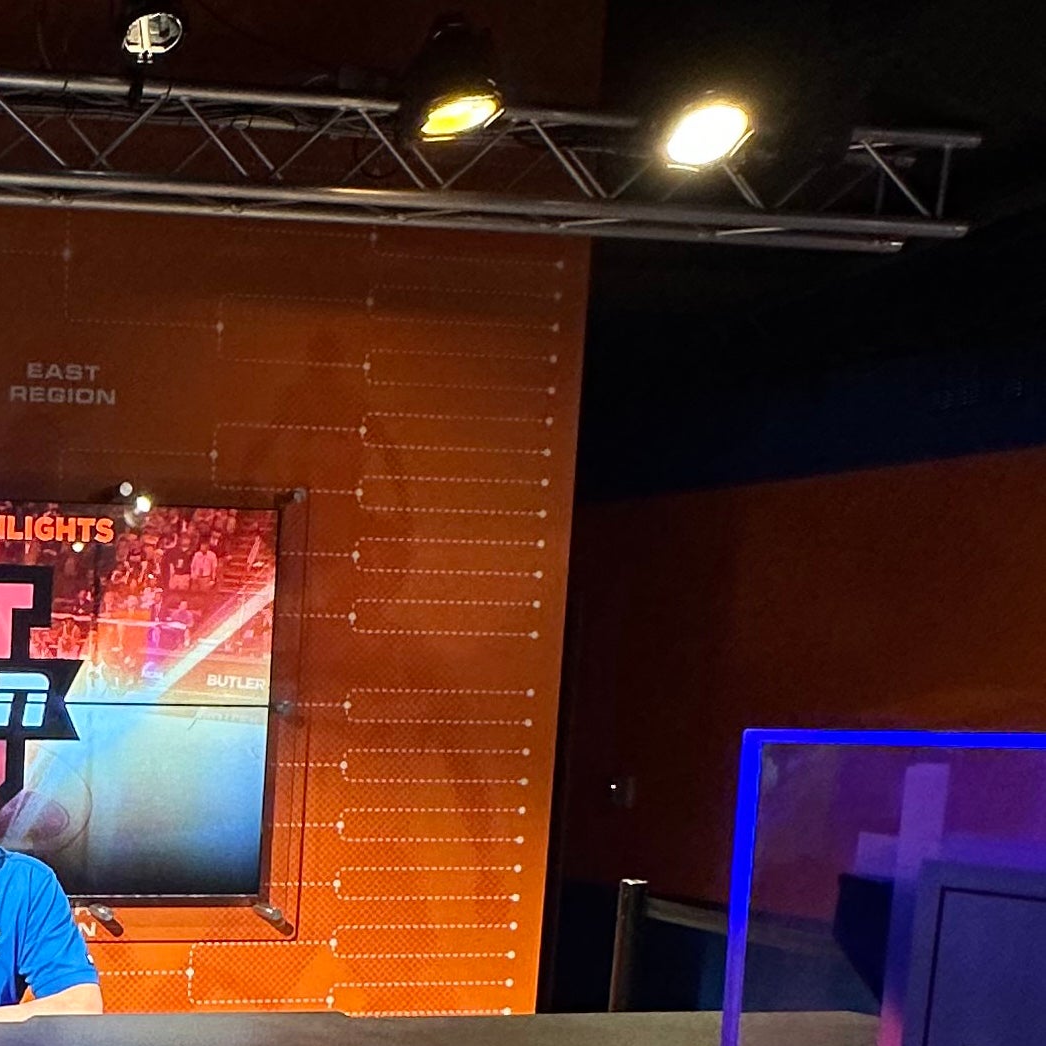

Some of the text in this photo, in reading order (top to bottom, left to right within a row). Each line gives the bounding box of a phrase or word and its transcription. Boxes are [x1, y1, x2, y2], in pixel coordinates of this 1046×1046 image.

[26, 362, 100, 381] EAST
[10, 385, 116, 405] REGION
[206, 674, 266, 690] BUTLER
